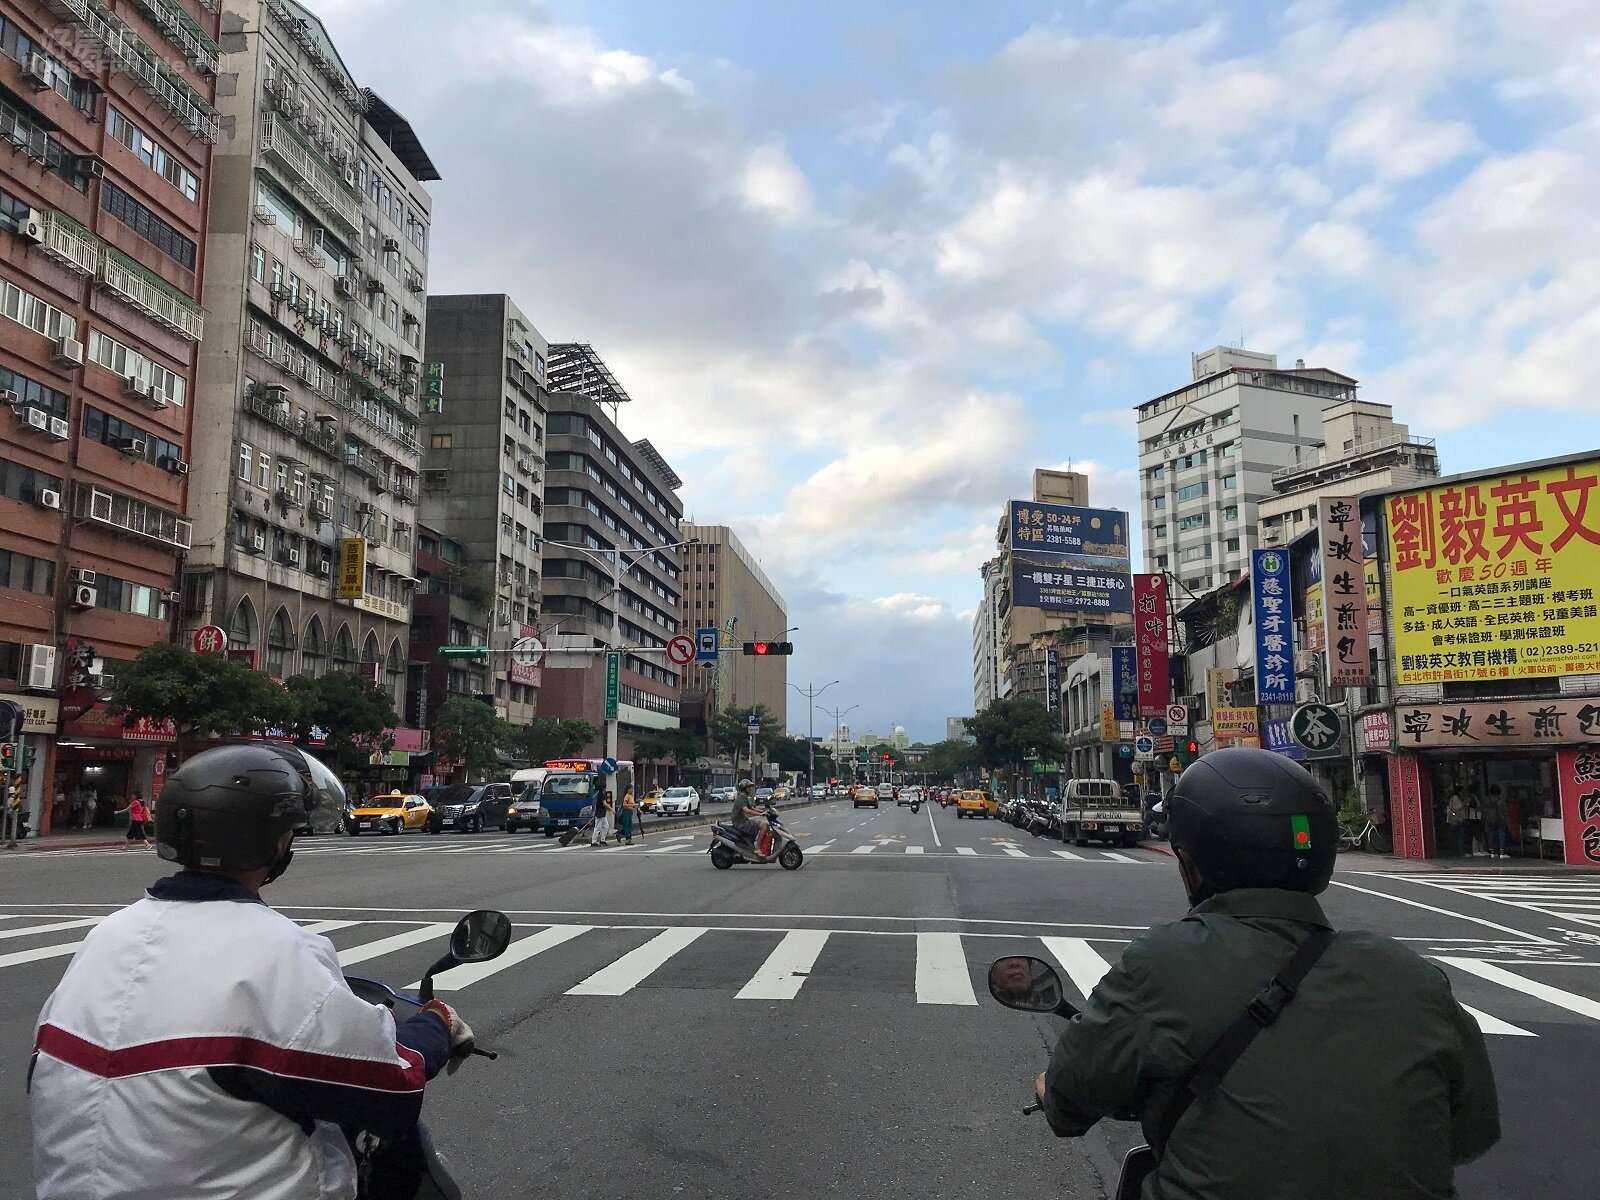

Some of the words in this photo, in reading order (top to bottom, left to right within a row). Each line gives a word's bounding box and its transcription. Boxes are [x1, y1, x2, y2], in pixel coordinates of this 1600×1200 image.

[1017, 508, 1044, 526] 博愛
[1390, 467, 1600, 573] 劉毅英文
[1047, 535, 1081, 545] 2381-5588
[1327, 501, 1362, 665] 寧波生煎包
[1436, 558, 1553, 584] 歡慶50週年
[1439, 577, 1552, 598] 一口氣英語系列講座
[1261, 577, 1289, 691] 慈聖牙醫診所
[1402, 648, 1518, 671] 劉毅英文教育機構
[1301, 708, 1336, 747] 茶
[1401, 704, 1600, 742] 寧波生煎包
